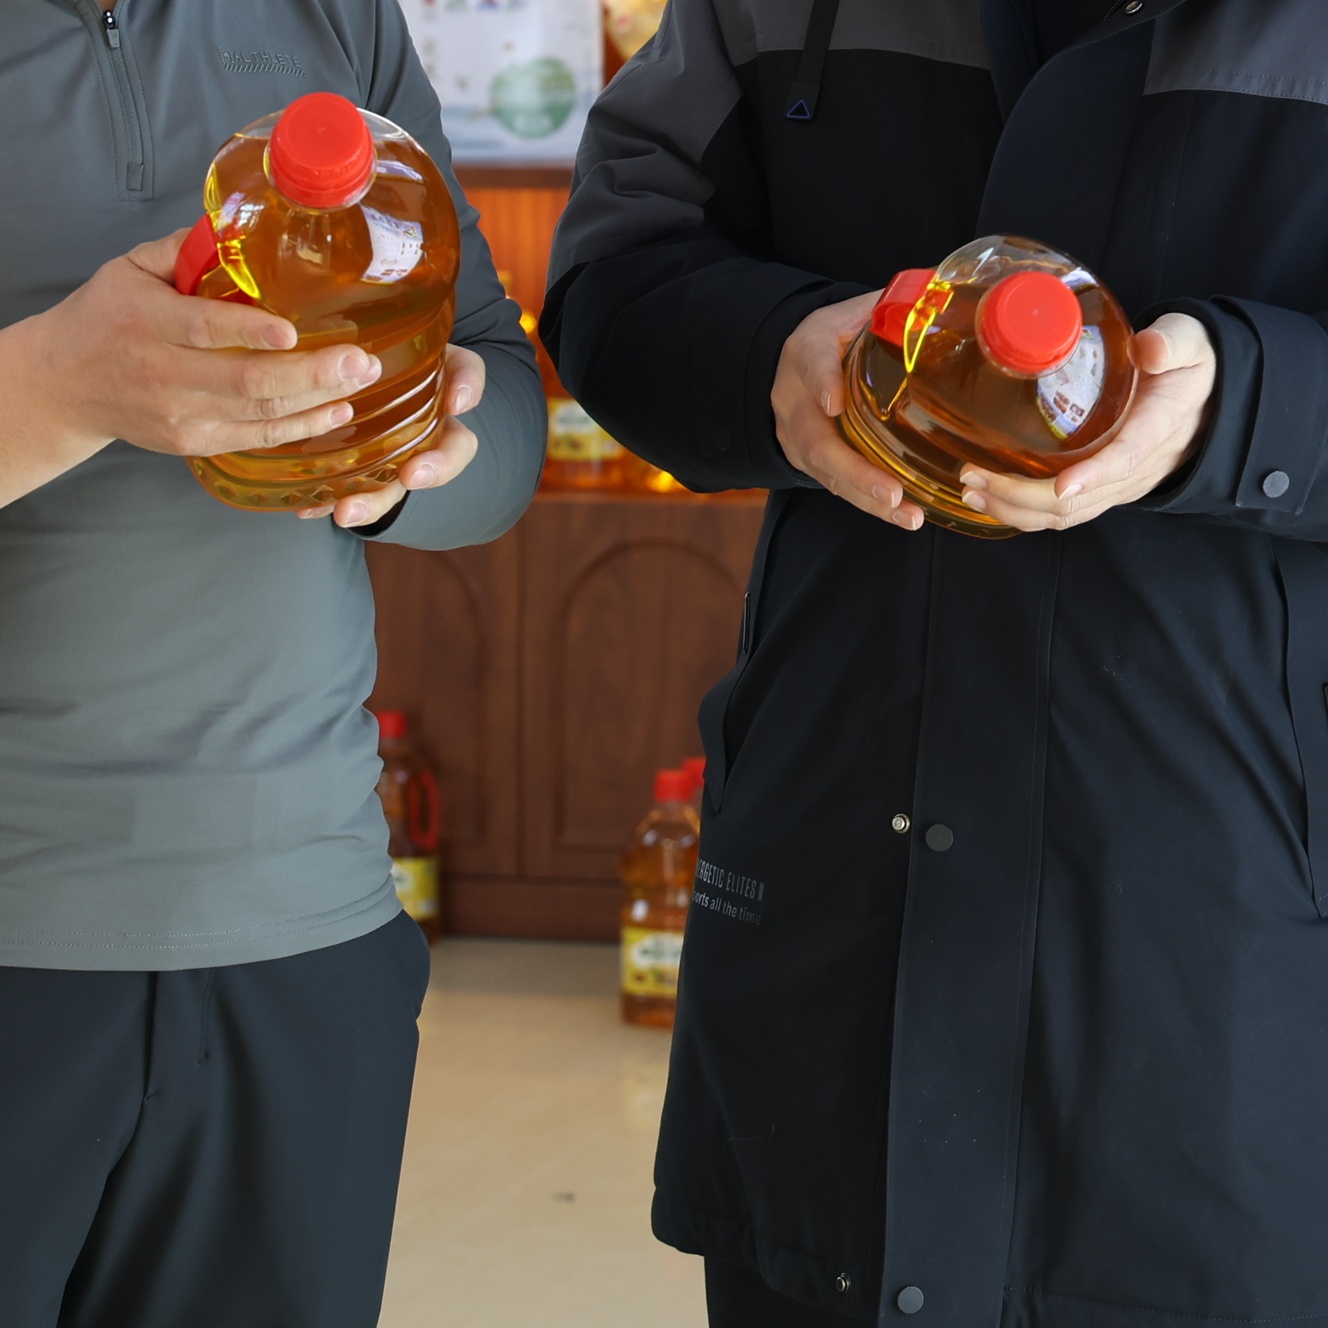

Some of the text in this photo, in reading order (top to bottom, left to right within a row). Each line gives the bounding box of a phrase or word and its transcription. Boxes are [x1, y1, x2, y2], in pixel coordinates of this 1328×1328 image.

[726, 871, 757, 900] ELITES
[709, 897, 722, 913] all
[722, 900, 738, 918] the
